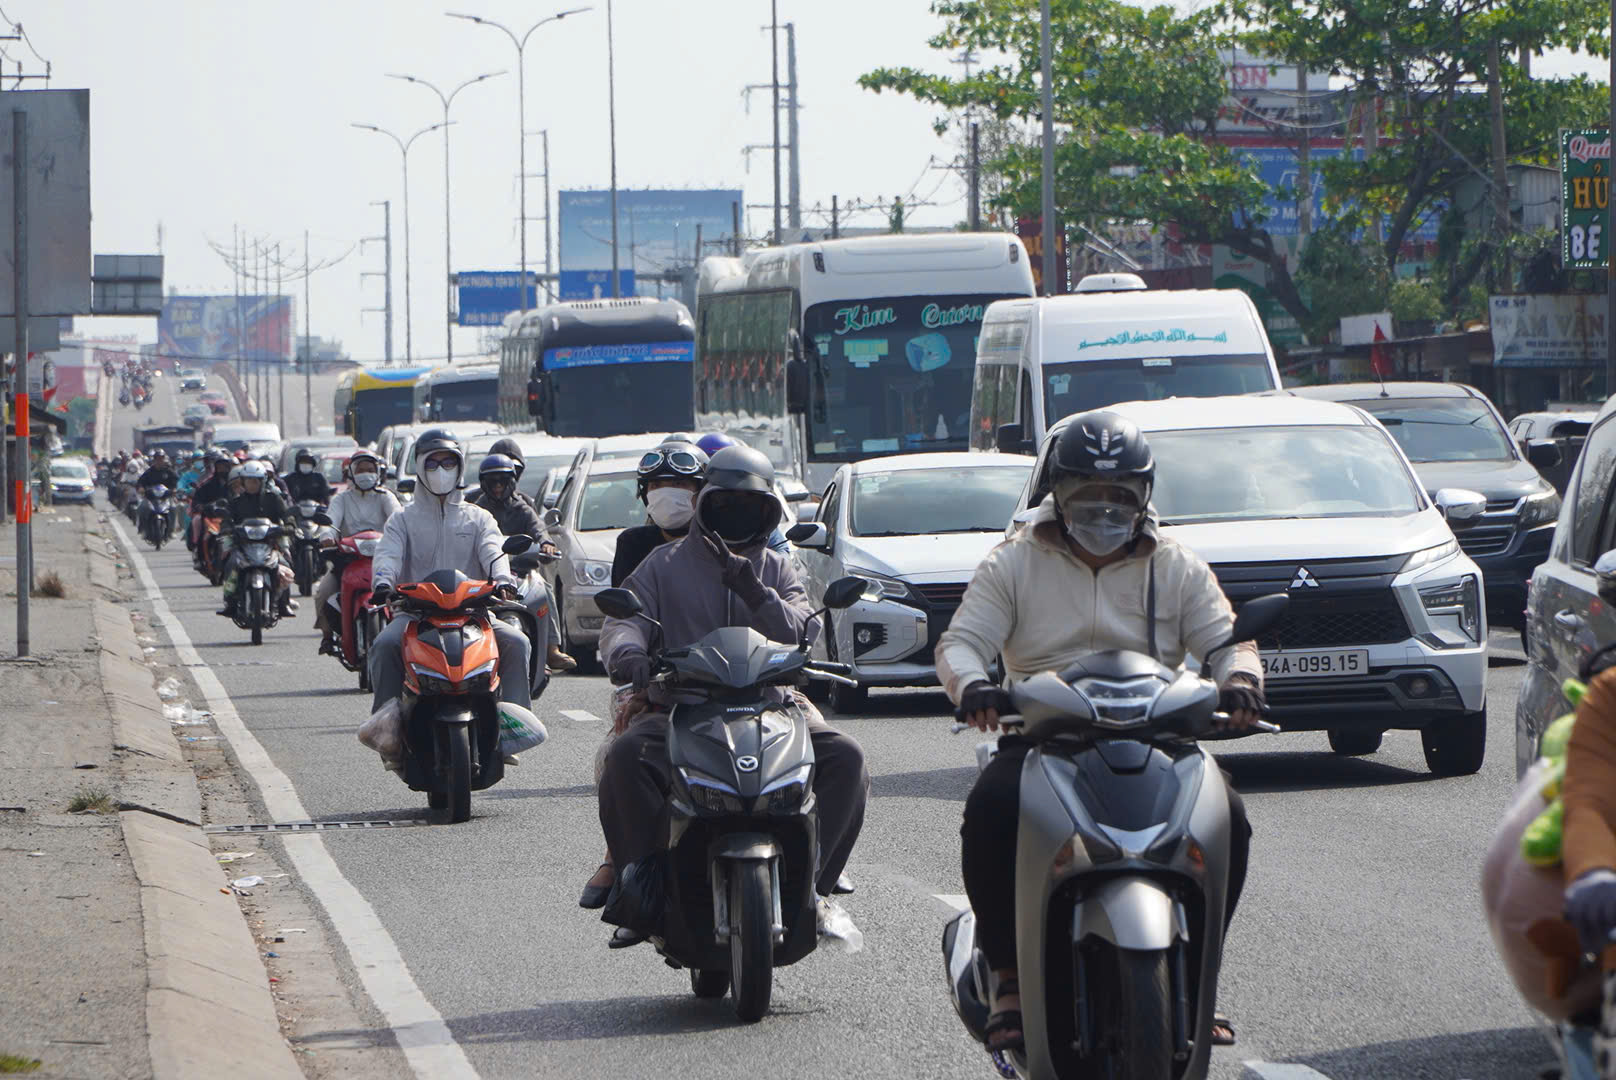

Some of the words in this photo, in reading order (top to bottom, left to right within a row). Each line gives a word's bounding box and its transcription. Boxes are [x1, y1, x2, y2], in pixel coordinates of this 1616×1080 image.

[1570, 215, 1602, 260] BÉ
[834, 304, 897, 335] Kim
[921, 303, 986, 329] Cươn
